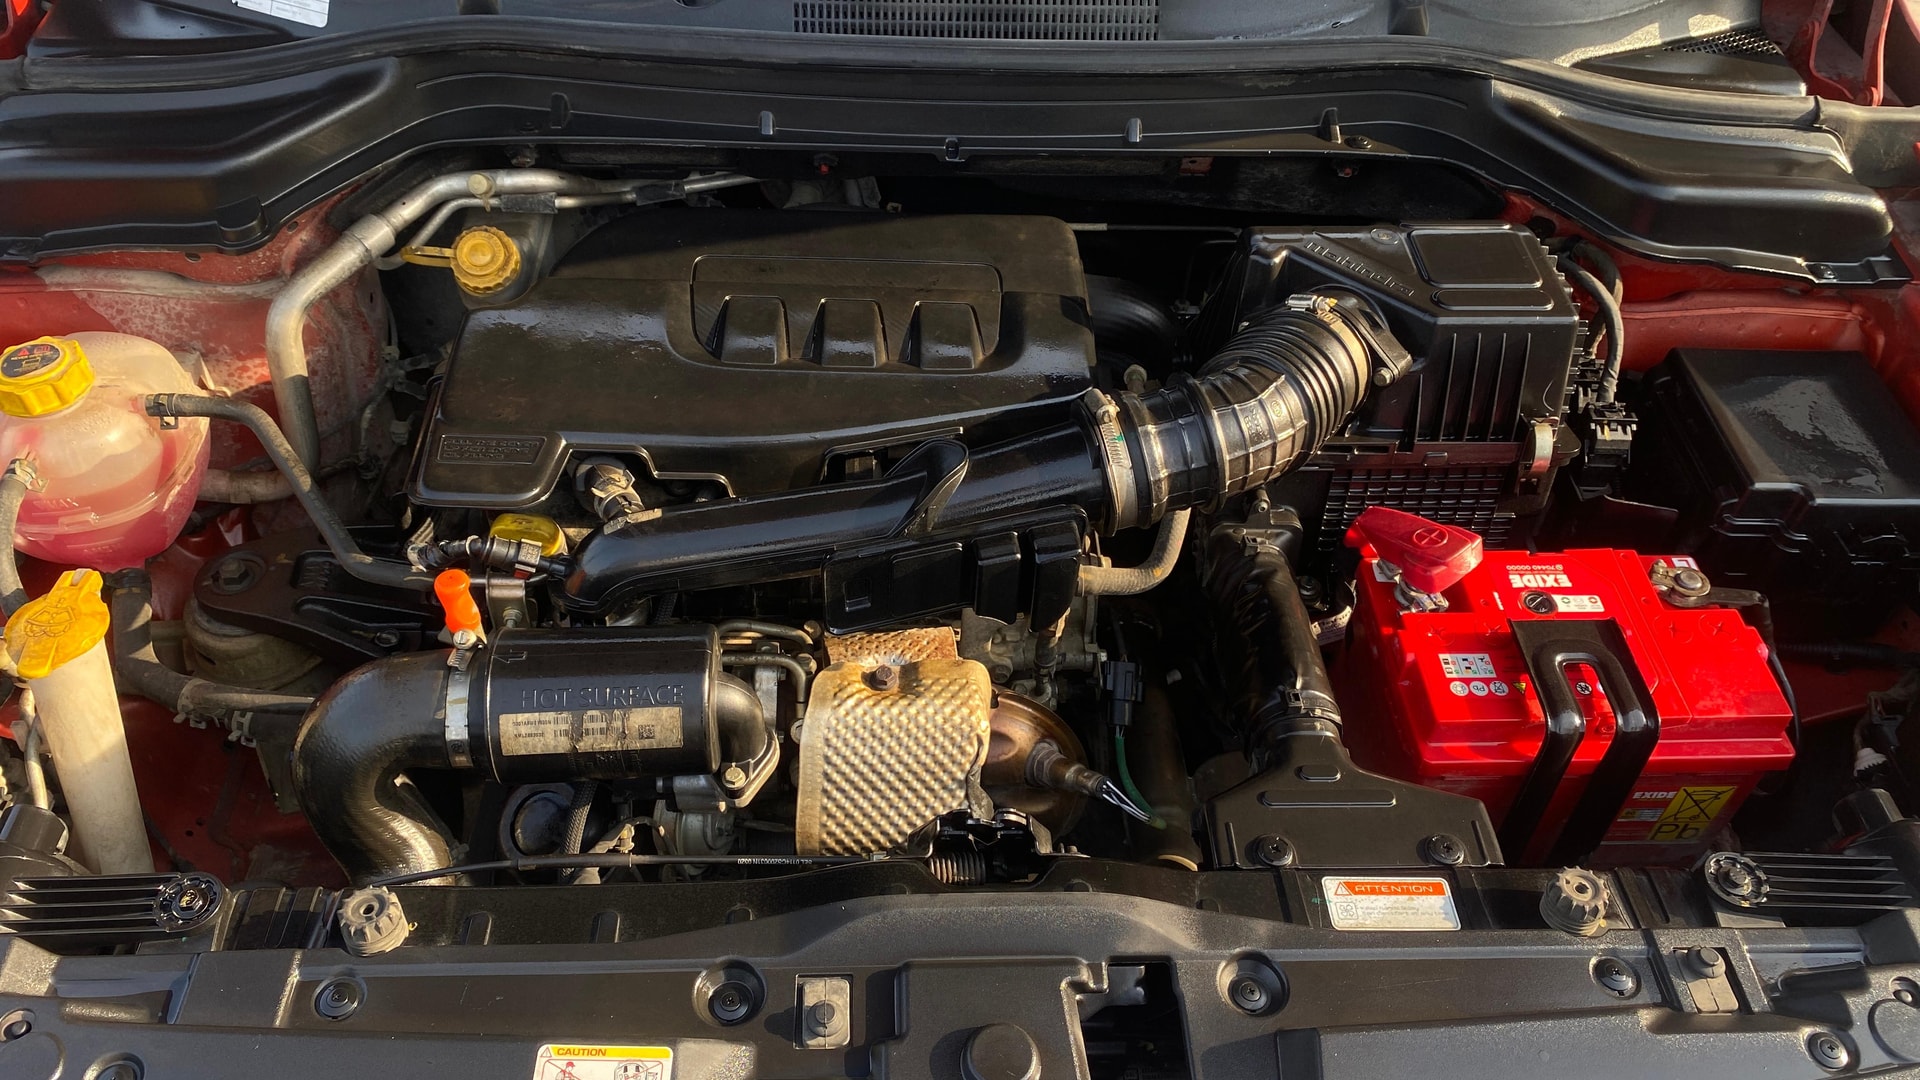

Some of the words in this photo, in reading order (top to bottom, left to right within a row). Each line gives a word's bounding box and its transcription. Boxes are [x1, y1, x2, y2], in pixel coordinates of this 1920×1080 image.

[1509, 574, 1572, 588] EXIDE
[521, 687, 572, 709] HOT
[579, 685, 684, 708] SURFACE
[1632, 791, 1677, 799] EXIDE
[1649, 823, 1700, 840] Pb
[1355, 884, 1433, 893] ATTENTION
[557, 1047, 607, 1057] CAUTION
